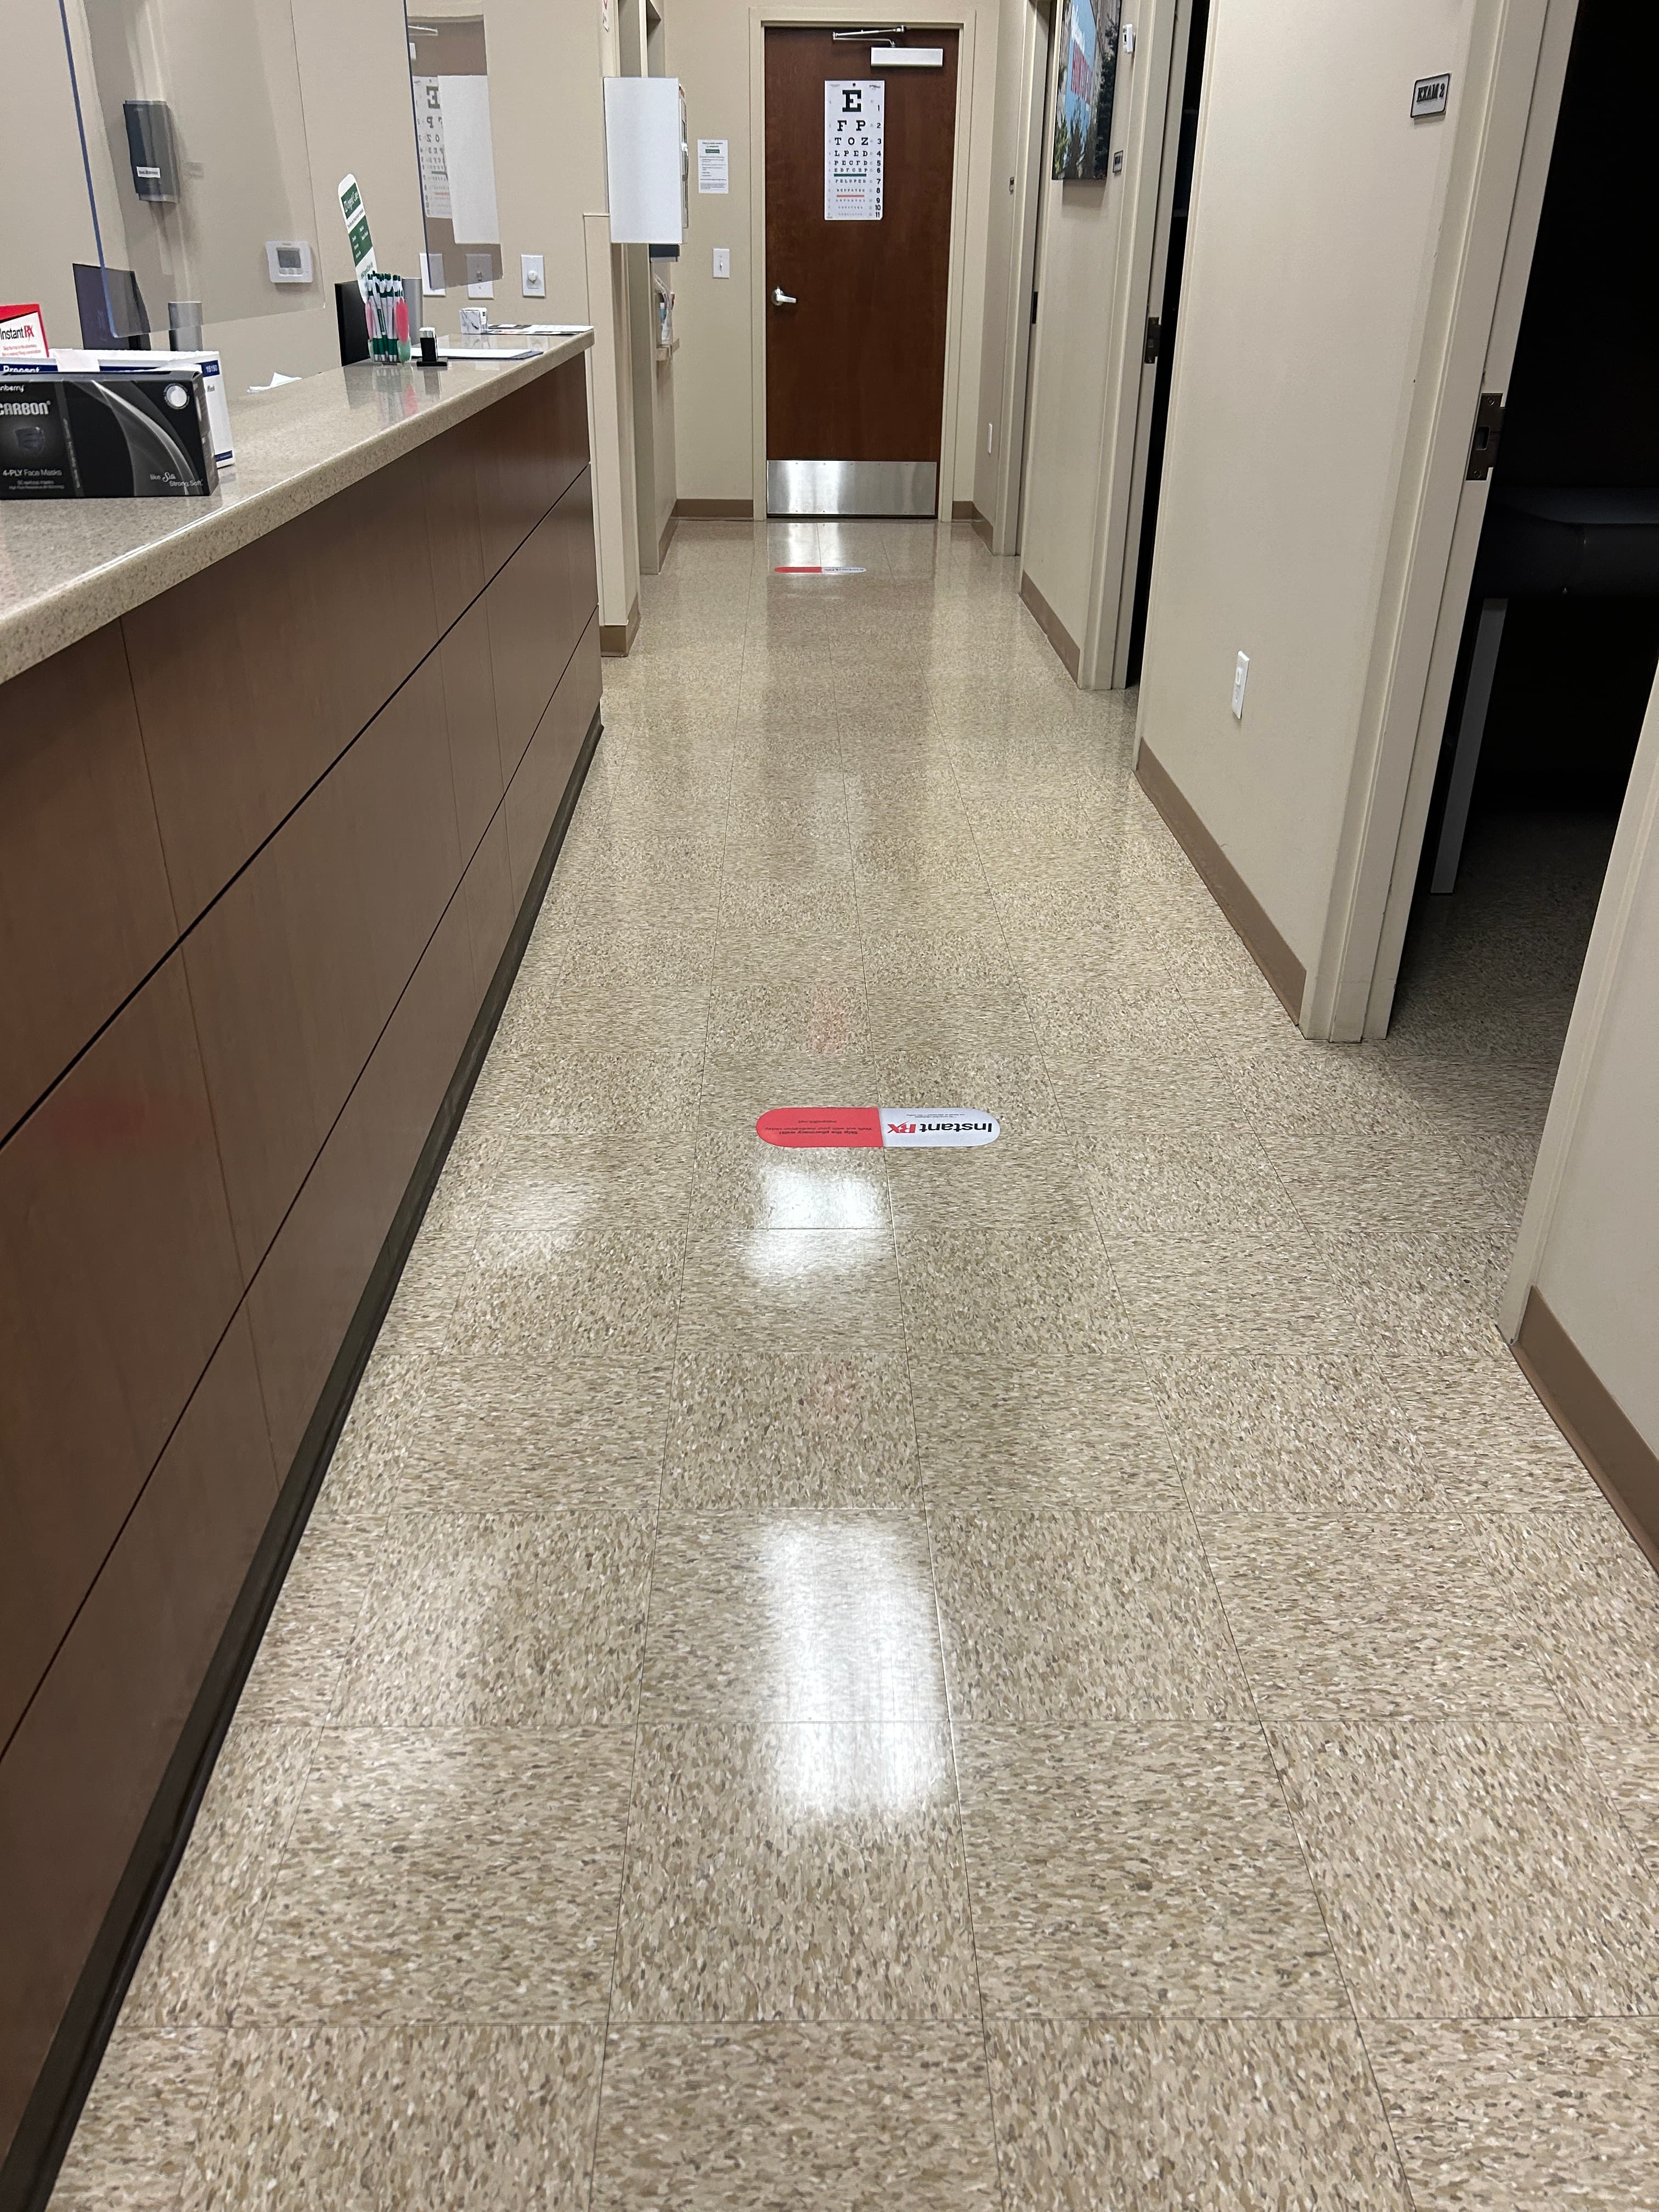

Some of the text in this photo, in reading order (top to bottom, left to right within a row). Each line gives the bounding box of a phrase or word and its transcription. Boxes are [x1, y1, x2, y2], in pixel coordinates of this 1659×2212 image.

[842, 89, 861, 112] E
[1416, 83, 1446, 103] EXAM 2
[0, 326, 24, 341] Instant
[919, 1123, 992, 1132] Instant
